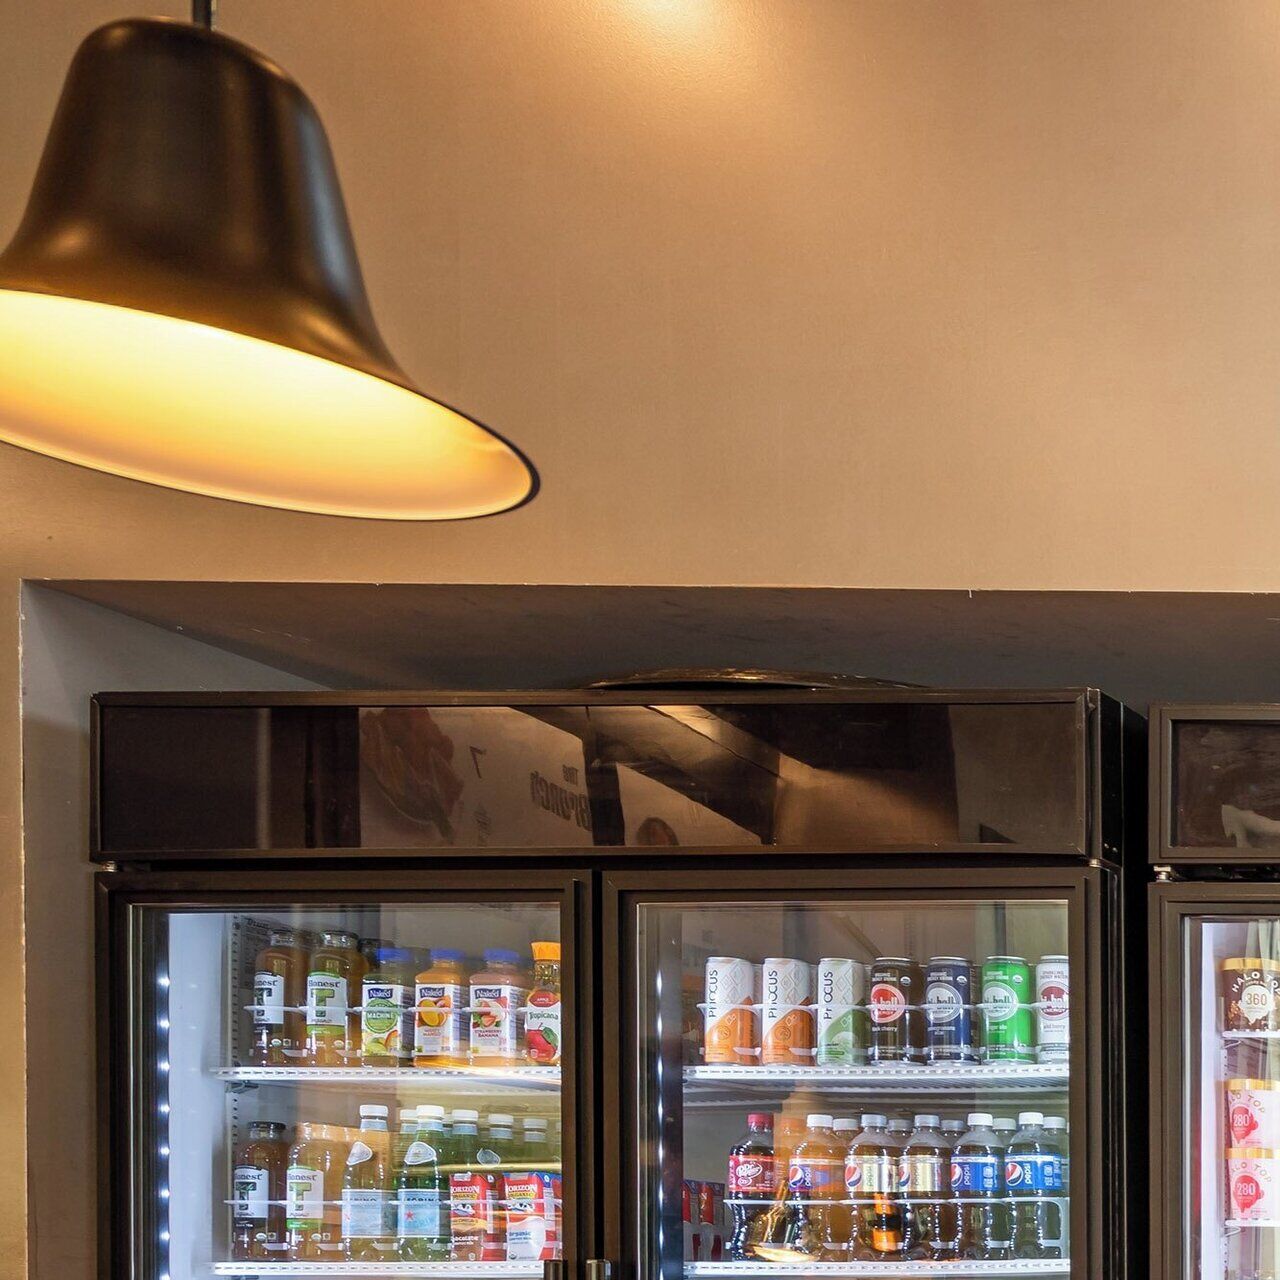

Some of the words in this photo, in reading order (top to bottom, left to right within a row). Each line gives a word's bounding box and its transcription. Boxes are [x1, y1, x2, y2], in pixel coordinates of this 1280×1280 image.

[1231, 971, 1260, 993] HALO
[370, 989, 391, 998] Naked
[420, 988, 443, 998] Naked
[476, 989, 500, 998] Naked
[1246, 992, 1267, 1006] 360
[529, 1011, 559, 1021] Tropicana
[963, 1164, 971, 1186] pepsi
[1024, 1163, 1033, 1185] pepsi
[1236, 1184, 1255, 1196] 280
